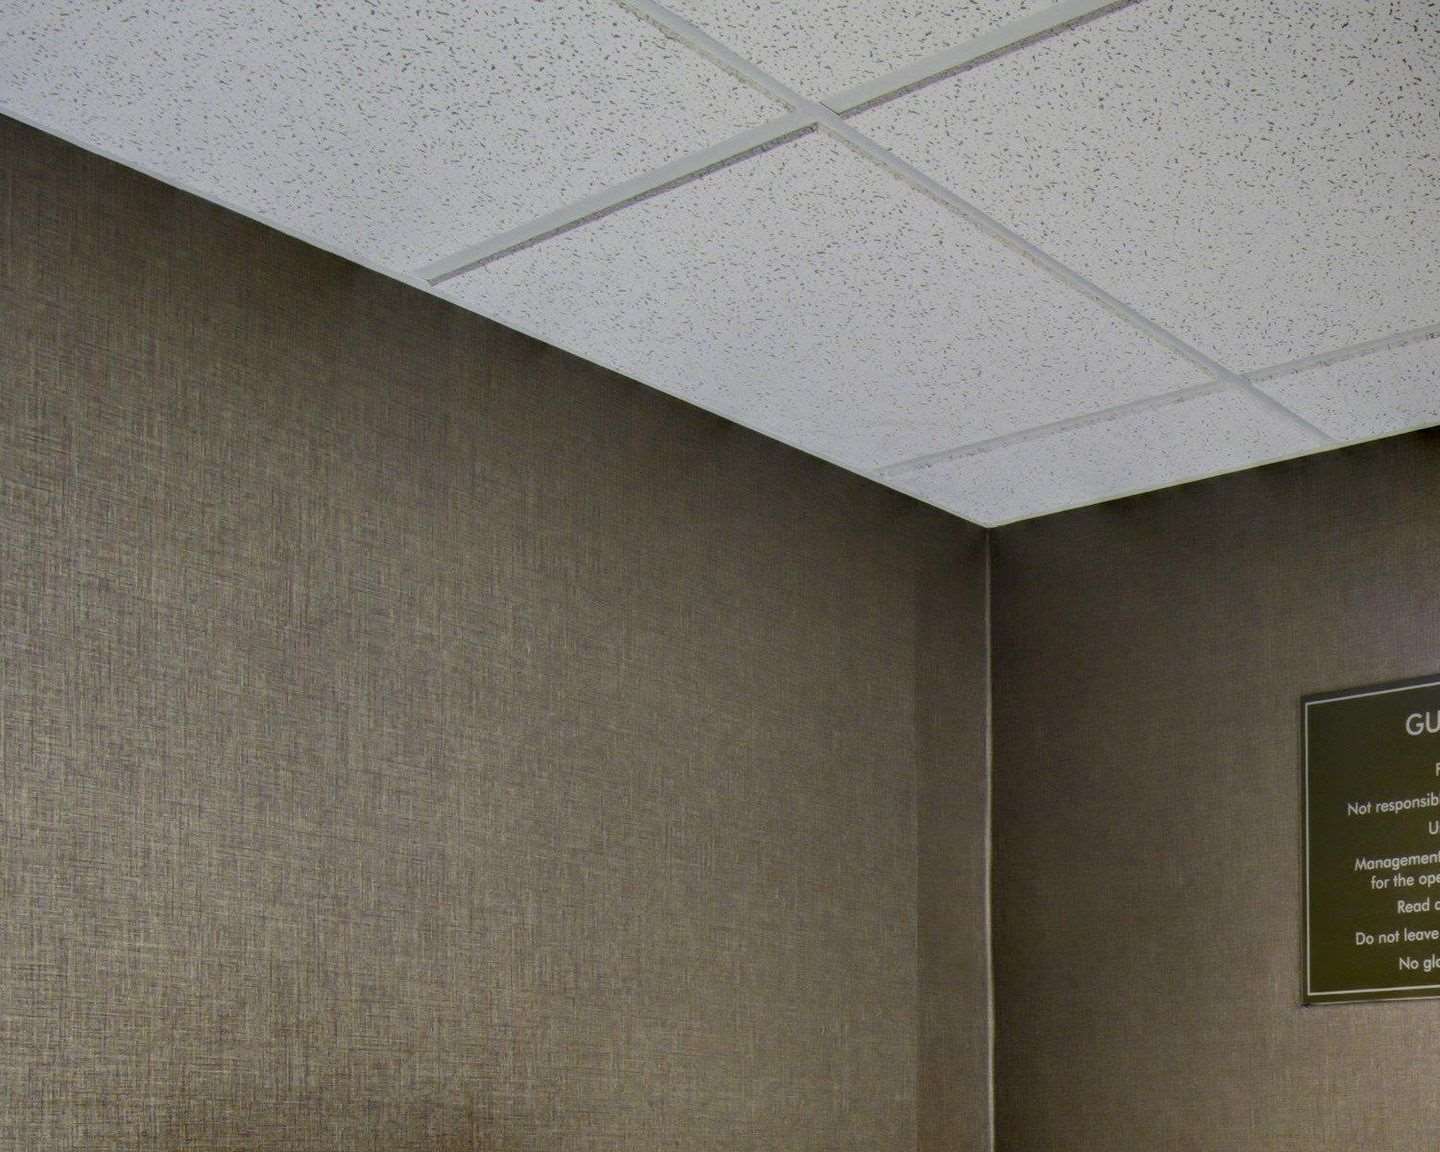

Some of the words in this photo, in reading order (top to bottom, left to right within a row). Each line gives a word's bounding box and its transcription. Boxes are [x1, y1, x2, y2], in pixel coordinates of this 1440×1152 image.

[1348, 801, 1371, 816] Not
[1371, 874, 1389, 890] for
[1393, 871, 1414, 888] the
[1398, 899, 1430, 913] Read
[1355, 931, 1374, 946] Do
[1379, 930, 1400, 945] not
[1404, 925, 1439, 942] leave
[1399, 956, 1419, 970] No
